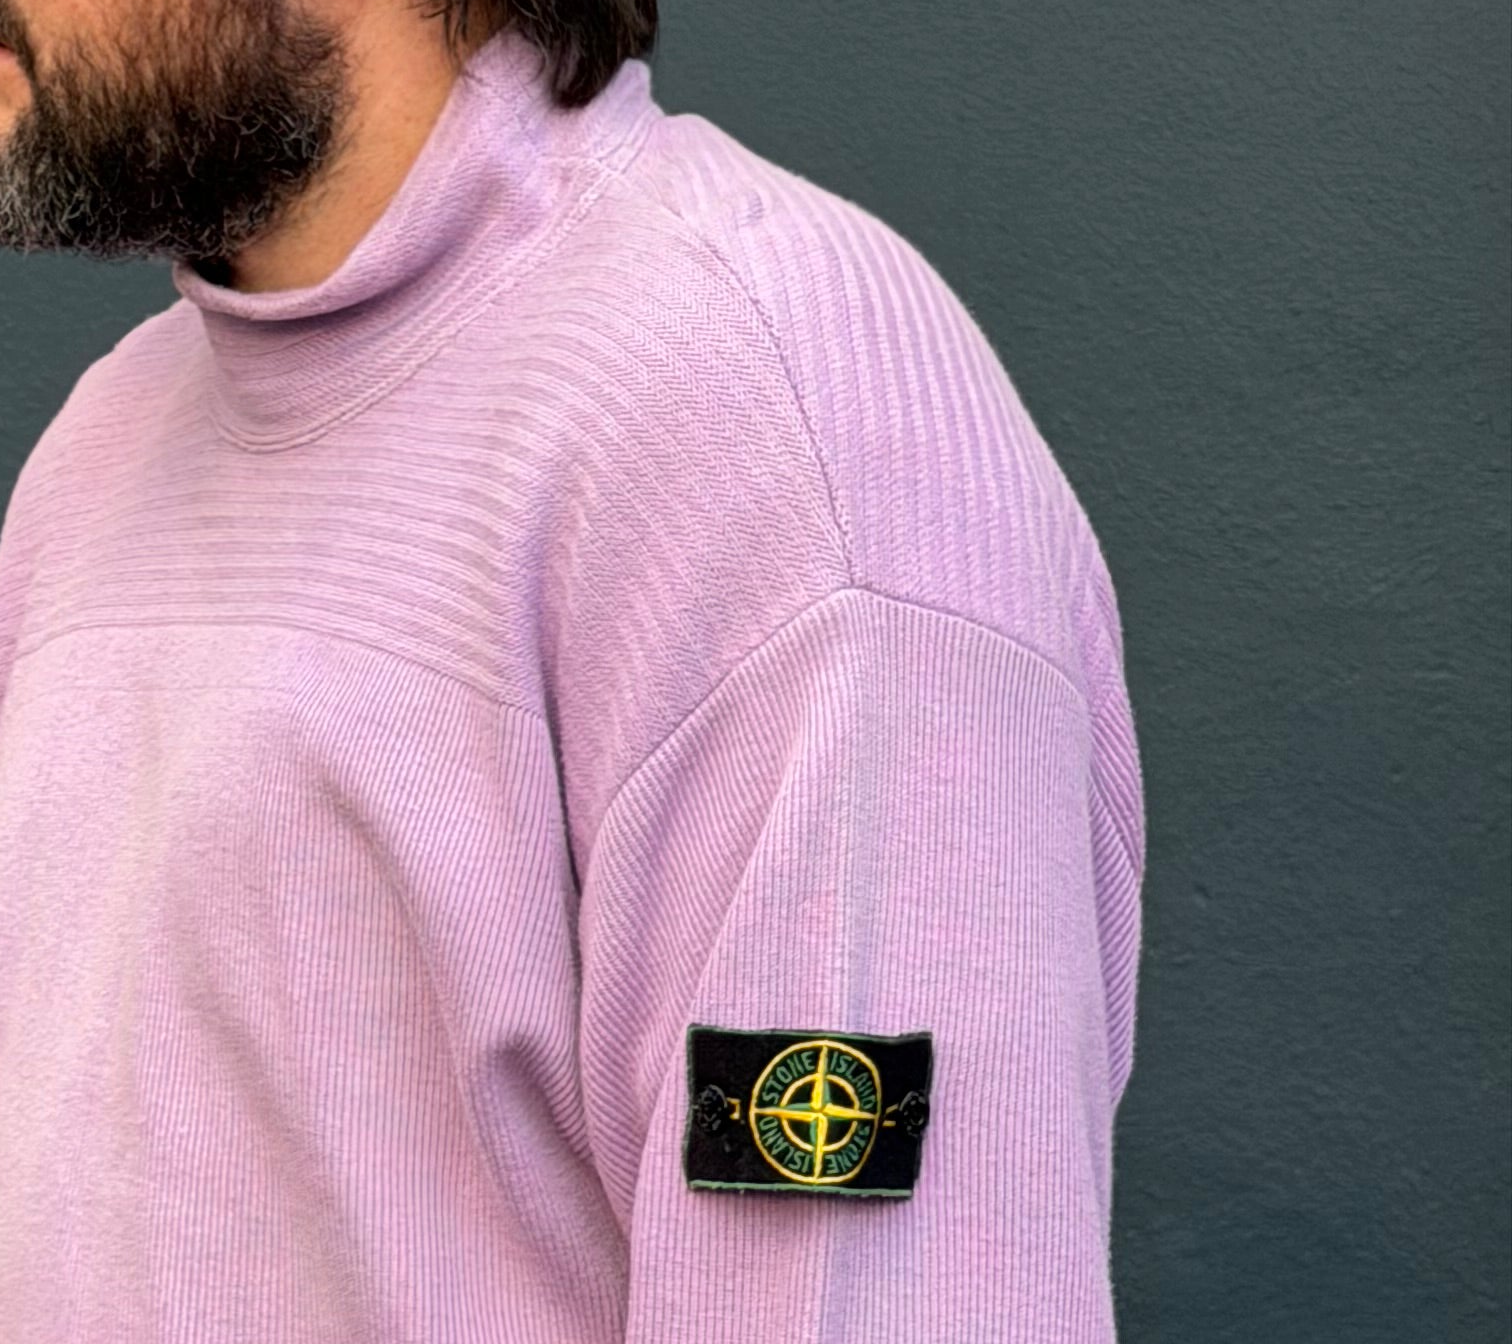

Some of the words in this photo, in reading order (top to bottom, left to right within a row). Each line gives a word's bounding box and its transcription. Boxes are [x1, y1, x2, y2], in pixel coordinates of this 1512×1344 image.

[762, 1051, 815, 1104] STONE
[830, 1051, 875, 1110] ISLAND
[759, 1117, 810, 1173] ISLAND
[826, 1125, 870, 1174] STONE
